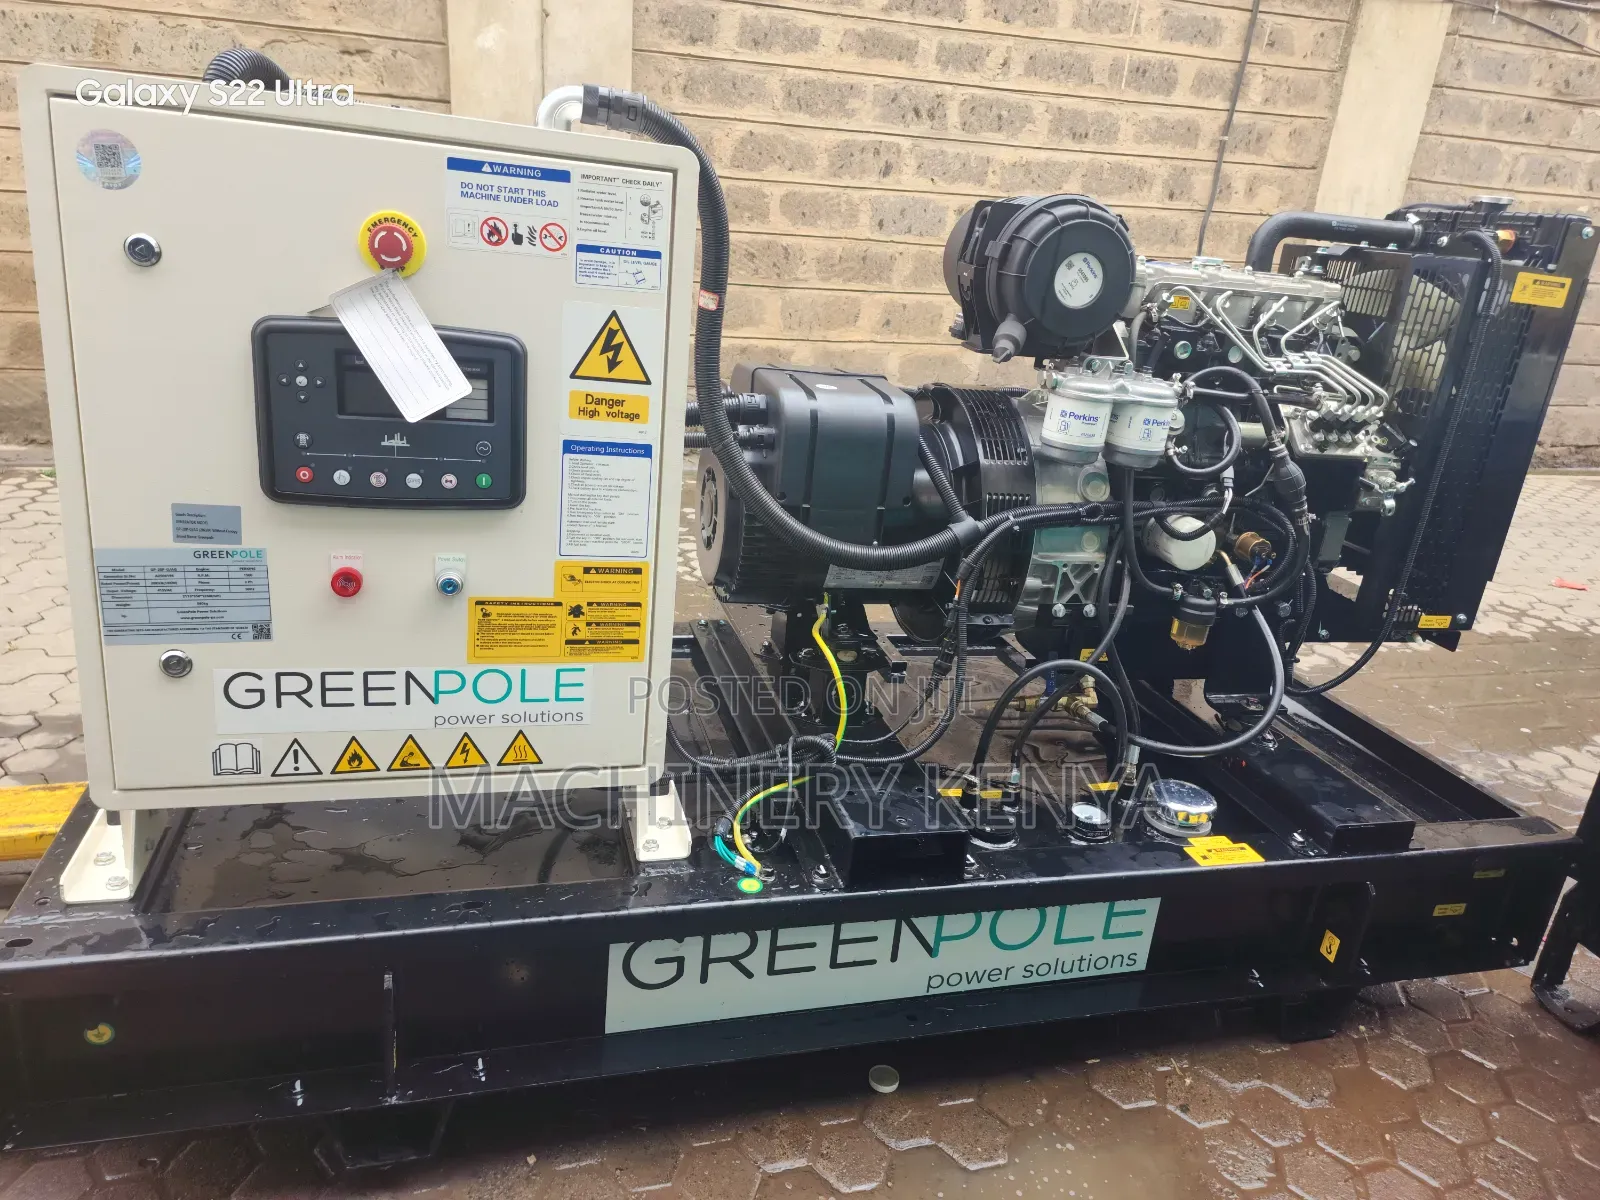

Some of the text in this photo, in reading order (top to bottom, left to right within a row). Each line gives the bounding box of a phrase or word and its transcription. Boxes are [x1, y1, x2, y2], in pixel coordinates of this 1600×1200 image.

[493, 164, 541, 177] WARNING
[460, 181, 546, 198] DO NOT START THIS
[621, 178, 642, 186] CHECK
[460, 191, 559, 208] MACHINE UNDER LOAD
[367, 216, 419, 239] EMERGENCY
[599, 247, 637, 257] CAUTION
[585, 393, 626, 409] Danger
[578, 406, 640, 422] High voltage
[1069, 411, 1100, 423] Perkins
[570, 444, 645, 454] Operating Instructions
[193, 550, 263, 559] GREENPOLE
[223, 667, 586, 710] GREENPOLE
[433, 709, 584, 728] power solutions
[621, 900, 1148, 990] GREENPOLE
[926, 949, 1138, 993] power solutions
